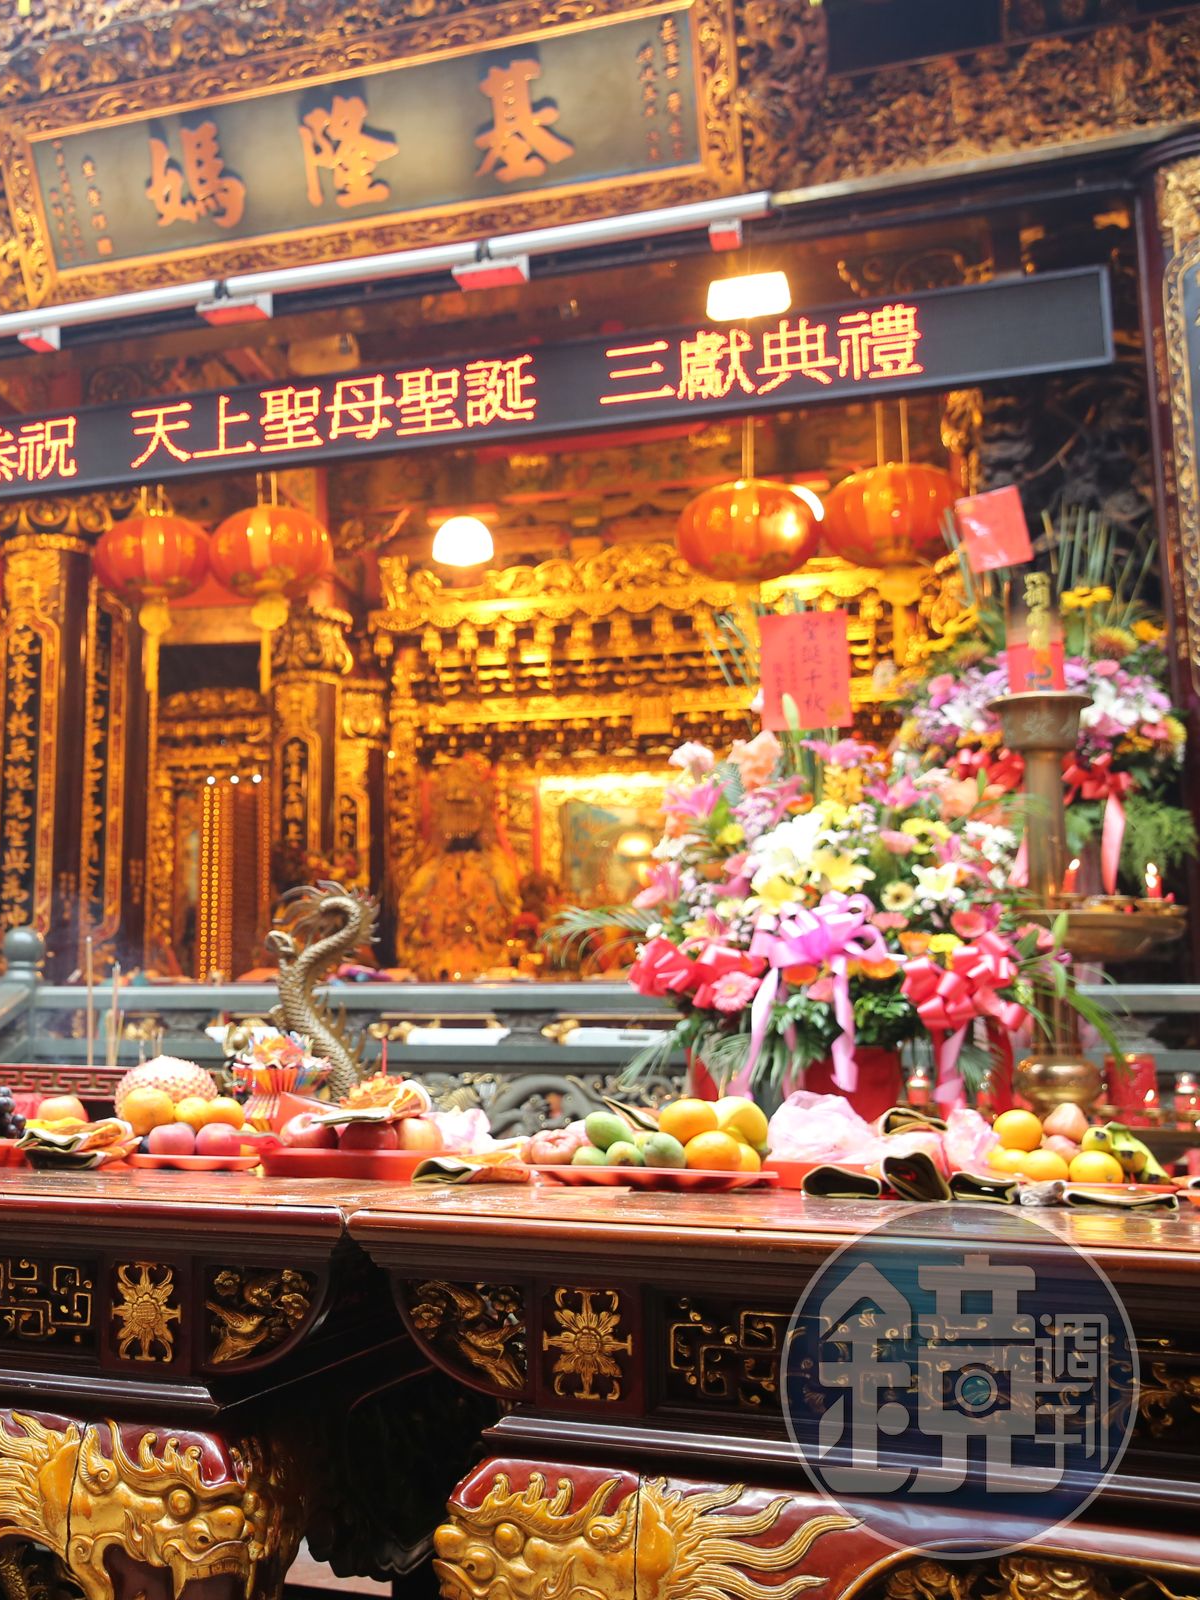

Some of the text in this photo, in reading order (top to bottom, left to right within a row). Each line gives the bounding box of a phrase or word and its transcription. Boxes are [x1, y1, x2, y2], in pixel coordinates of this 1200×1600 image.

[145, 59, 576, 228] 基隆媽
[130, 354, 537, 469] 天上聖母聖誕
[599, 303, 924, 405] 三獻典禮
